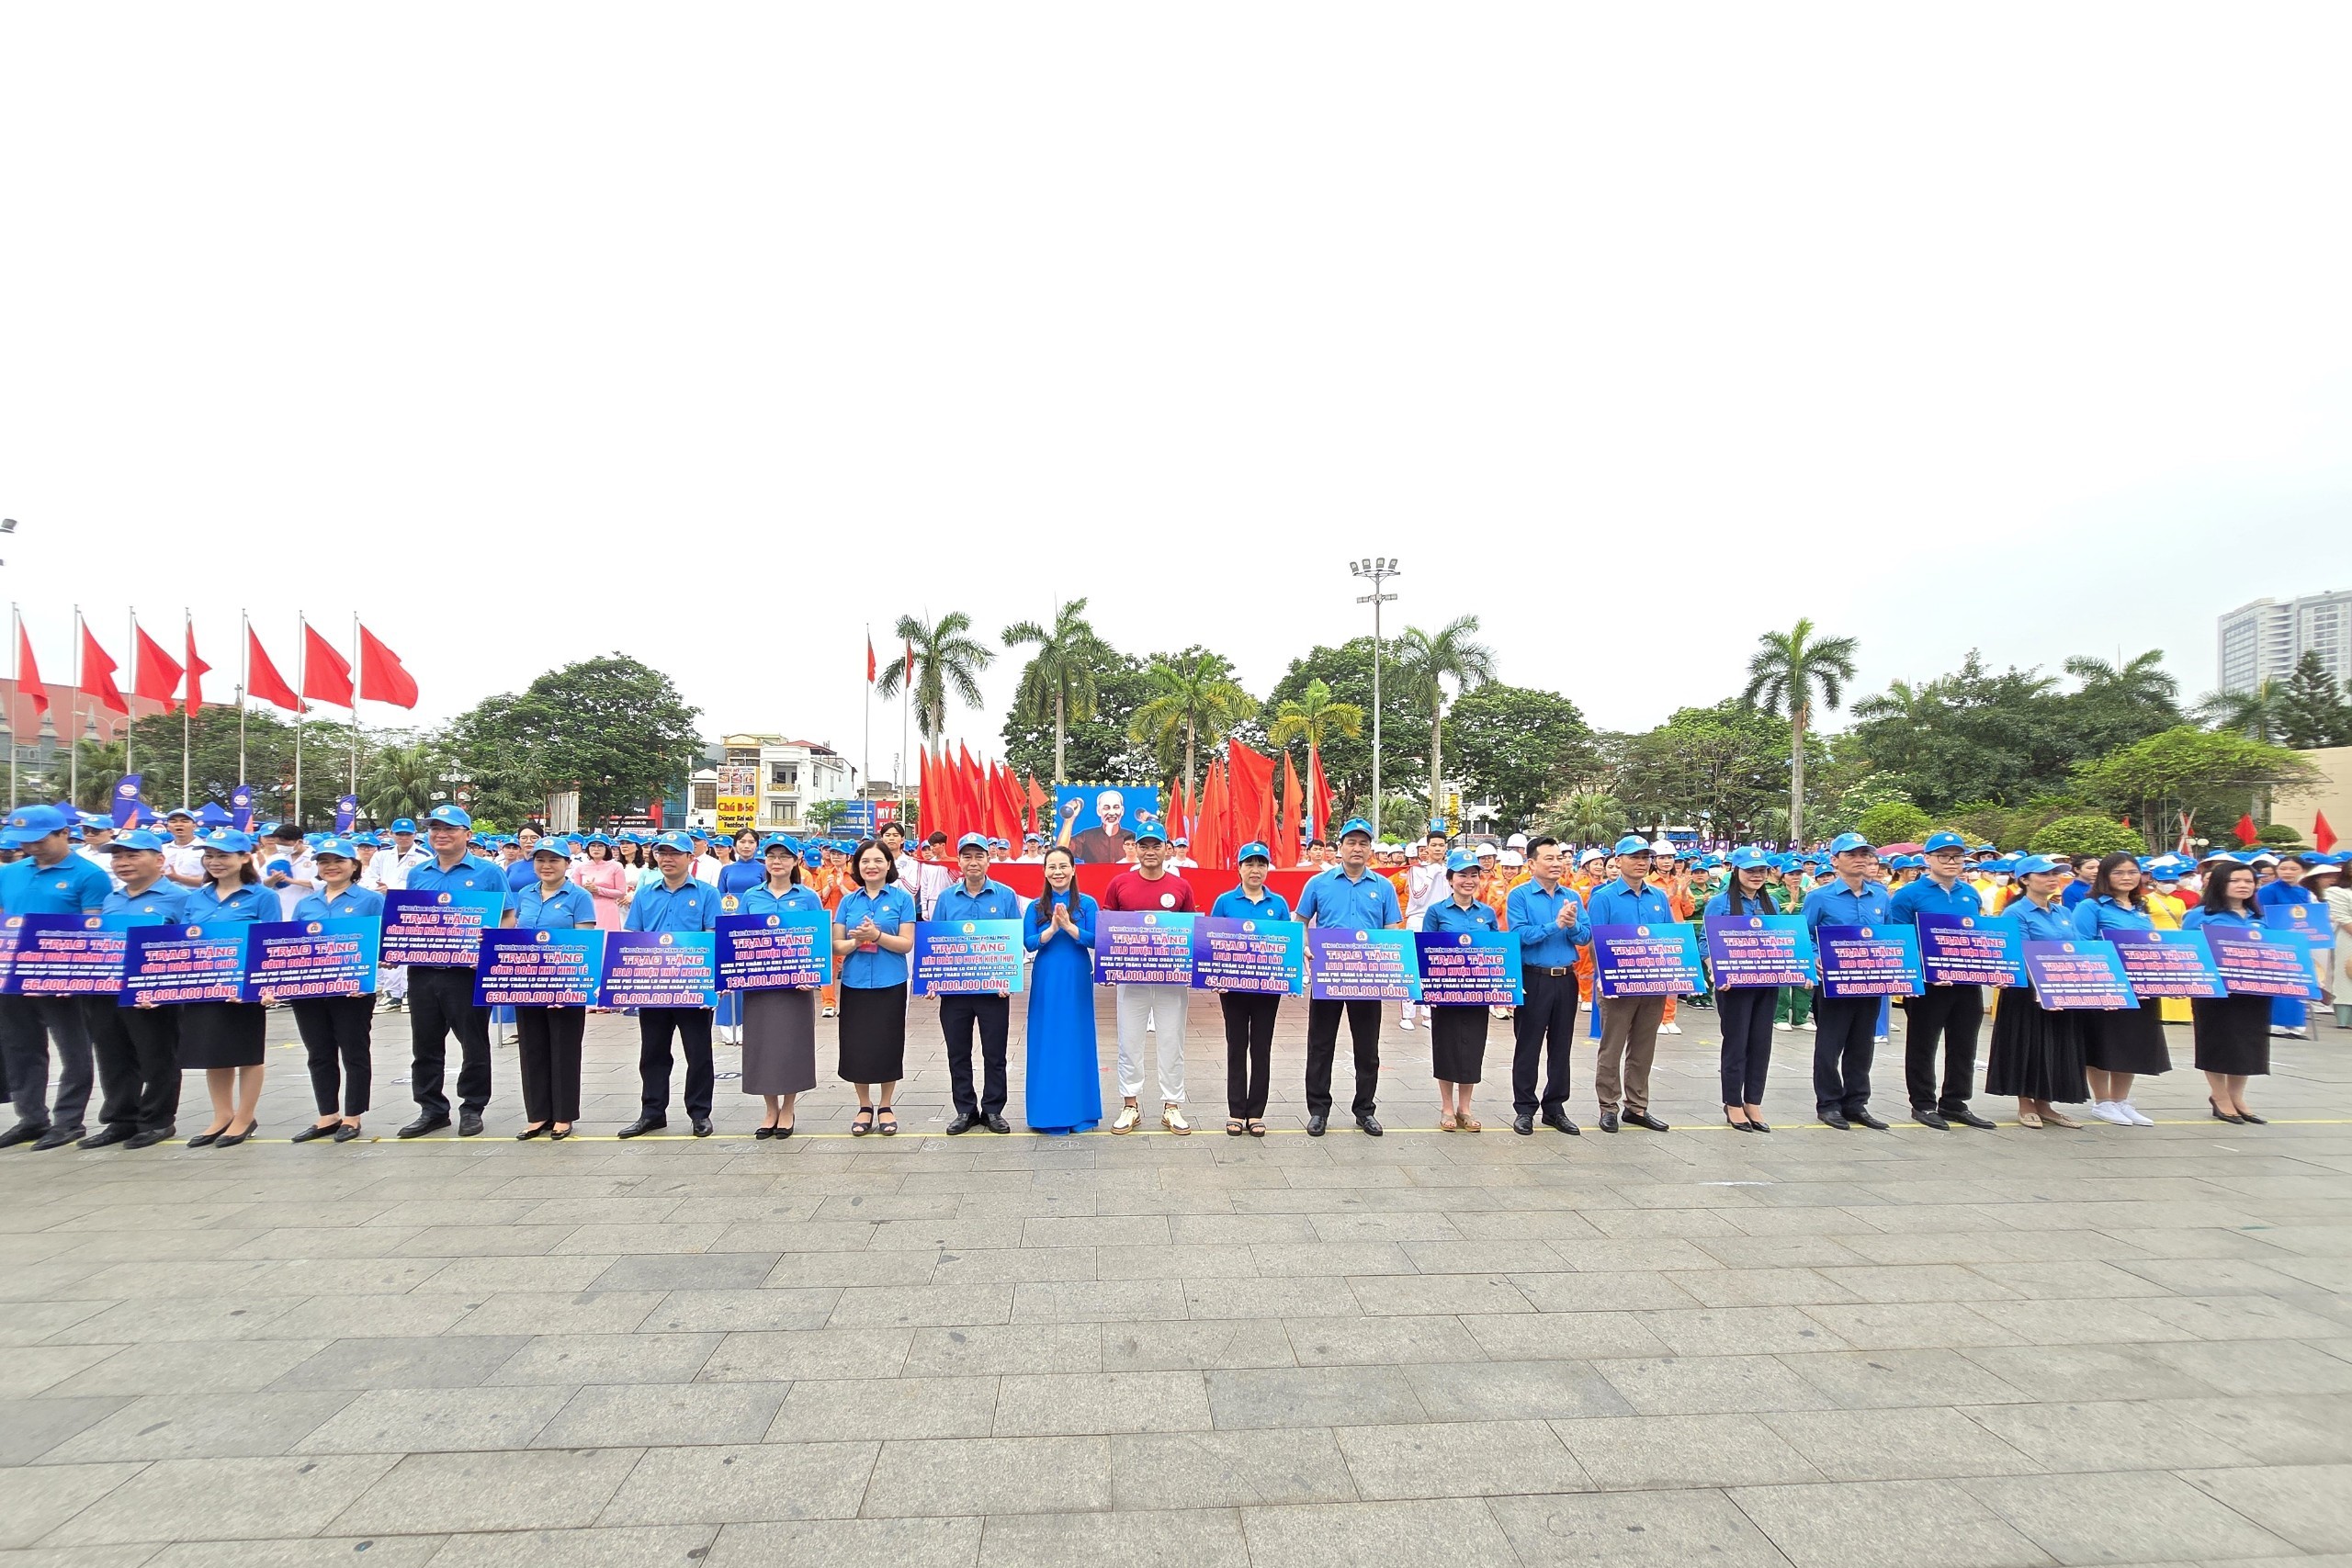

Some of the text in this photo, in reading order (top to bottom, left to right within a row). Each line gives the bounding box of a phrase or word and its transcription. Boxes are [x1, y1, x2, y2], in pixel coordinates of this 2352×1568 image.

[718, 802, 735, 812] Chú
[401, 913, 481, 926] TRAO TẶNG
[386, 924, 404, 935] CÔNG
[405, 926, 423, 935] ĐOÀN
[39, 939, 86, 951] TRAO
[733, 934, 813, 949] TRAO TẶNG
[1113, 933, 1187, 946] TRAO TẶNG
[1724, 936, 1795, 947] TRAO TẶNG
[1935, 935, 2007, 948] TRAO TẶNG
[266, 942, 358, 957] TRAO TẶNG
[756, 948, 780, 959] HUYỆN
[798, 946, 811, 956] HẢI
[932, 942, 1007, 954] TRAO TẶNG
[1130, 945, 1153, 956] HUYỆN
[1211, 940, 1286, 953] TRAO TẶNG
[1611, 944, 1682, 956] TRAO TẶNG
[1835, 946, 1904, 958] TRAO TẶNG
[145, 946, 237, 961] TRAO TẶNG
[385, 951, 450, 963] 634.000.000
[498, 952, 583, 964] TRAO TẶNG
[1327, 950, 1400, 962] TRAO TẶNG
[1429, 953, 1504, 966] TRAO TẶNG
[262, 960, 286, 969] CÔNG
[288, 957, 311, 968] ĐOÀN
[345, 955, 350, 964] Y
[623, 954, 704, 967] TRAO TẶNG
[141, 963, 166, 974] CÔNG
[167, 961, 192, 972] ĐOÀN
[491, 964, 513, 975] CÔNG
[514, 964, 537, 975] ĐOÀN
[579, 964, 588, 974] TẾ
[726, 969, 820, 987] 134.000.000 ĐỒNG
[1105, 970, 1164, 981] 175.000.000
[1726, 973, 1779, 984] 25.000.000
[1937, 970, 1986, 982] 40.000.000
[22, 978, 94, 990] 56.000.000
[258, 977, 359, 997] 45.000.000 ĐỒNG
[927, 977, 1009, 991] 40.000.000 ĐỒNG
[1205, 976, 1289, 990] 45.000.000 ĐỒNG
[1614, 981, 1668, 993] 70.000.000
[1837, 983, 1886, 994] 35.000.000
[135, 983, 238, 1002] 35.000.000 ĐỒNG
[486, 988, 587, 1002] 630.000.000 ĐỒNG
[1327, 984, 1408, 997] 48.000.000 ĐỒNG
[1424, 988, 1512, 1002] 343.000.000 ĐỒNG
[613, 990, 704, 1005] 60.000.000 ĐỒNG
